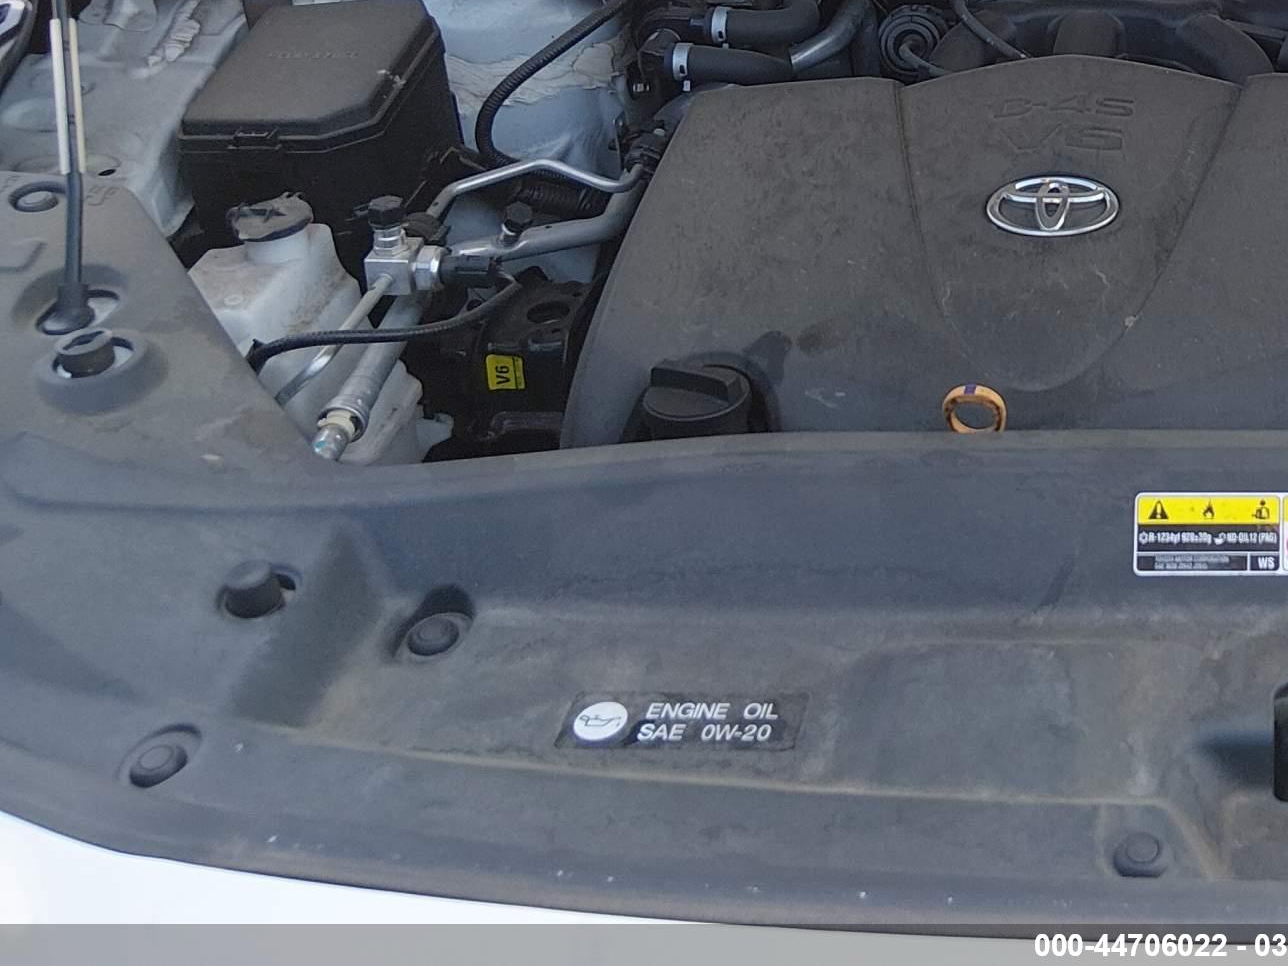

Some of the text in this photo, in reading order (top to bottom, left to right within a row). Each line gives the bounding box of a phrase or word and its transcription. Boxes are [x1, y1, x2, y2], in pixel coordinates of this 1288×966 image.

[993, 94, 1135, 118] D-4S
[998, 122, 1125, 151] V6
[496, 366, 511, 385] V6
[1257, 556, 1276, 570] WS
[645, 702, 779, 720] ENGINE OIL
[636, 723, 772, 742] SAE 0W-20
